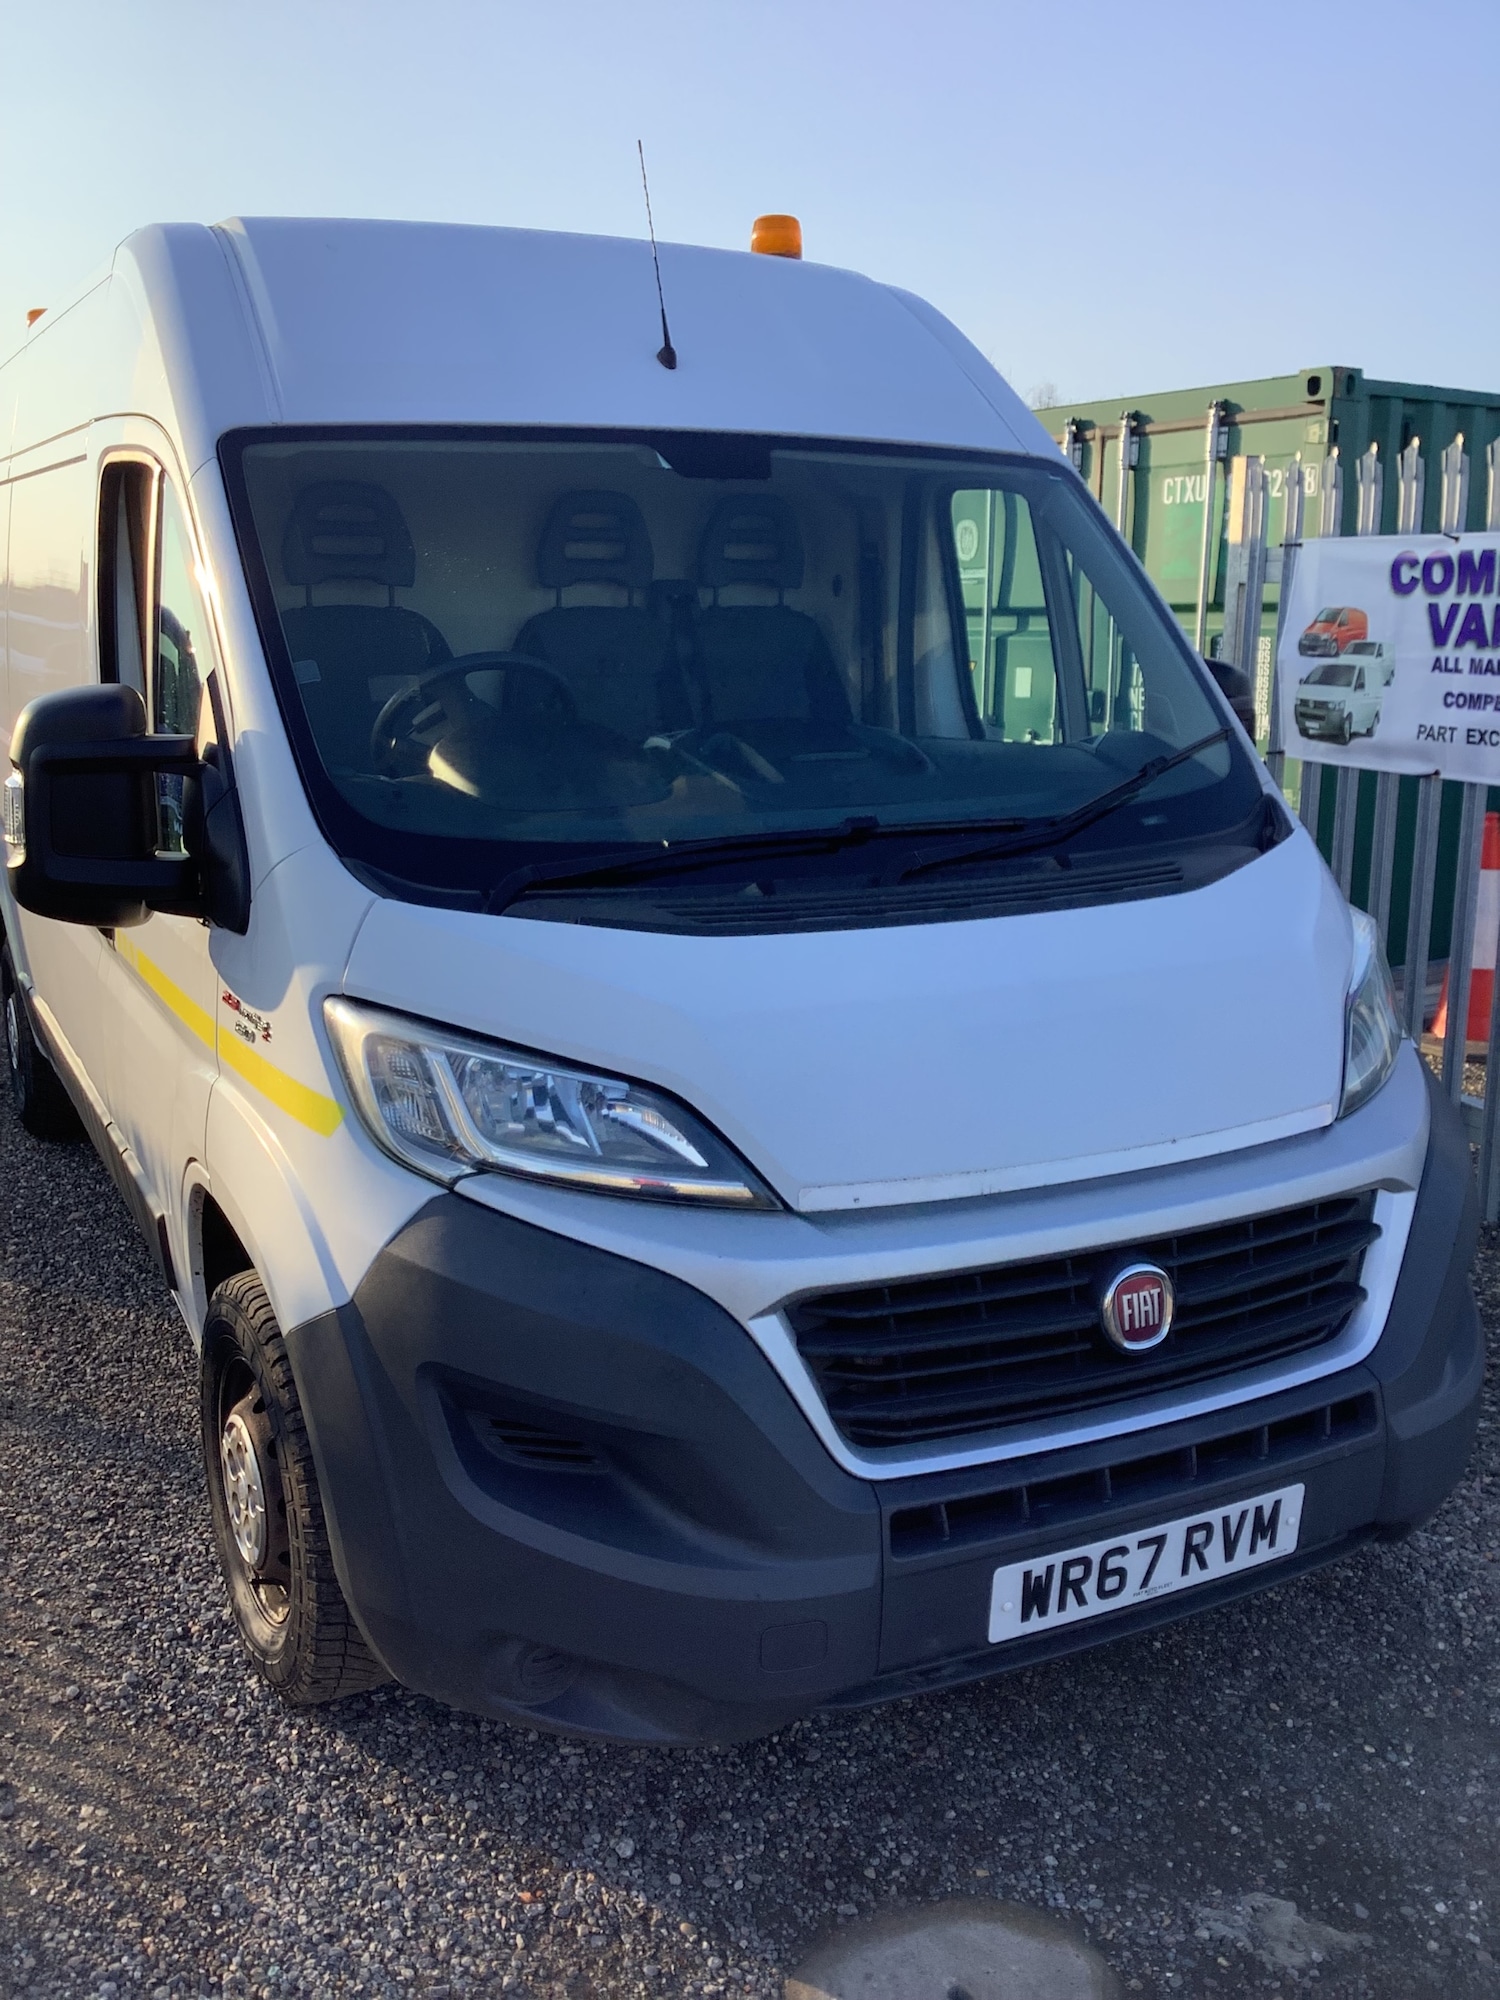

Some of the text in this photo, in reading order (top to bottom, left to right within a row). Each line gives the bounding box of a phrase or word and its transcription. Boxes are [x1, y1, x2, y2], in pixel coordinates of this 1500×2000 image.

[1163, 474, 1206, 504] CTXU
[1390, 549, 1500, 597] COM
[1428, 602, 1500, 649] VA
[1431, 656, 1500, 676] ALL MA
[1417, 723, 1458, 743] PART
[1122, 1288, 1161, 1331] FIAT
[1021, 1499, 1282, 1623] WR67 RVM
